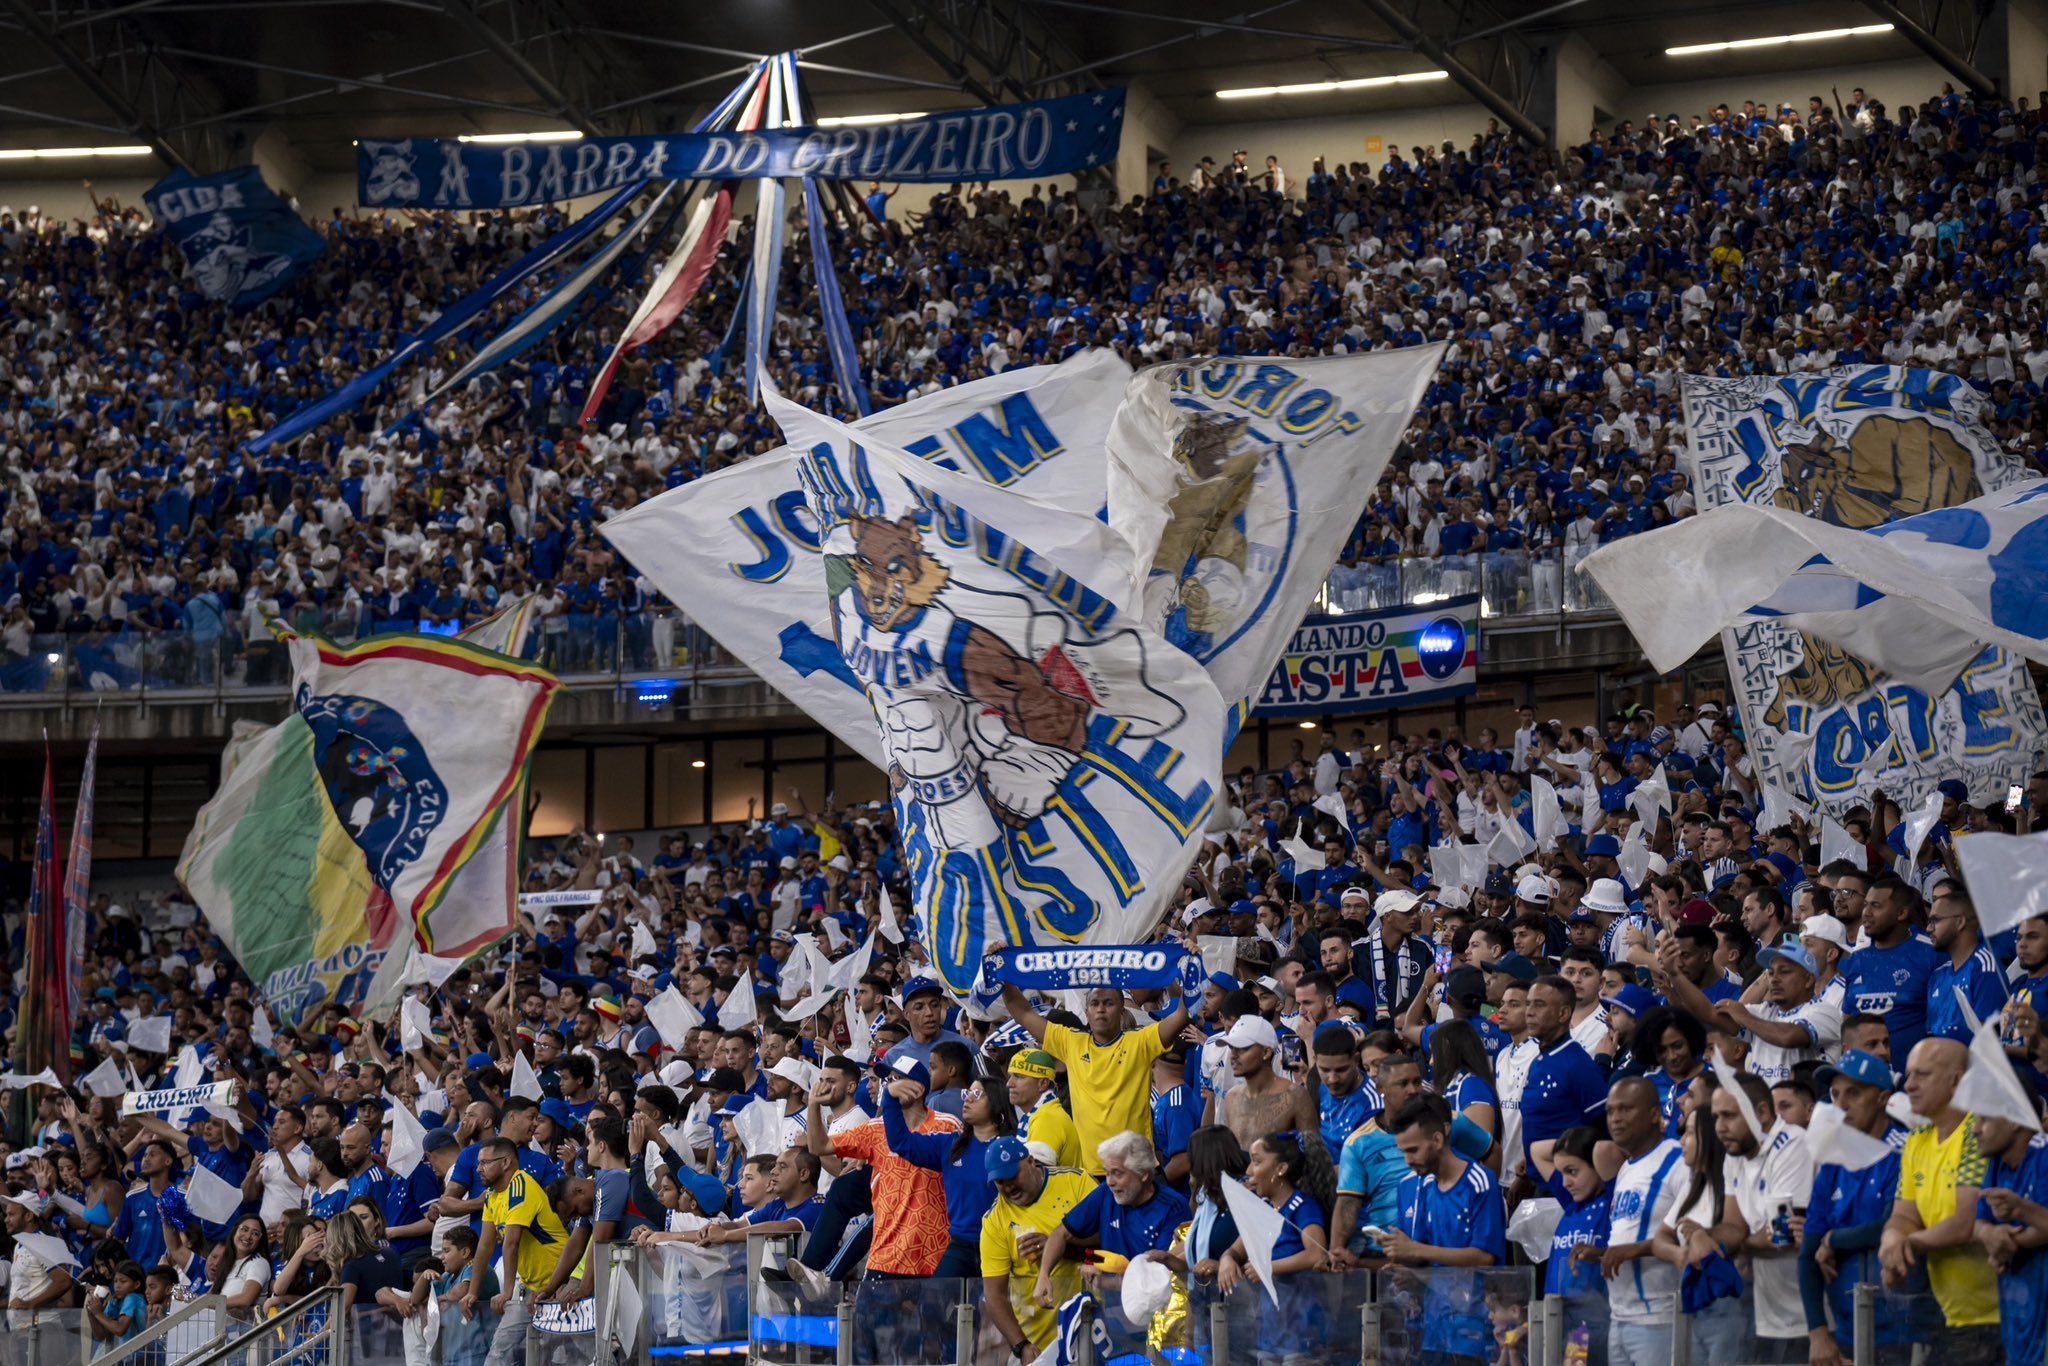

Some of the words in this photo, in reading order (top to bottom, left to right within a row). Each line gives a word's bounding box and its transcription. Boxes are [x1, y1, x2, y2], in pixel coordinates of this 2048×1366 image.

[434, 141, 472, 206] A
[501, 141, 669, 206] BARRA
[693, 134, 770, 178] DO
[791, 107, 1053, 180] CRUZEIRO
[1015, 949, 1167, 973] CRUZEIRO
[1068, 968, 1112, 986] 1921
